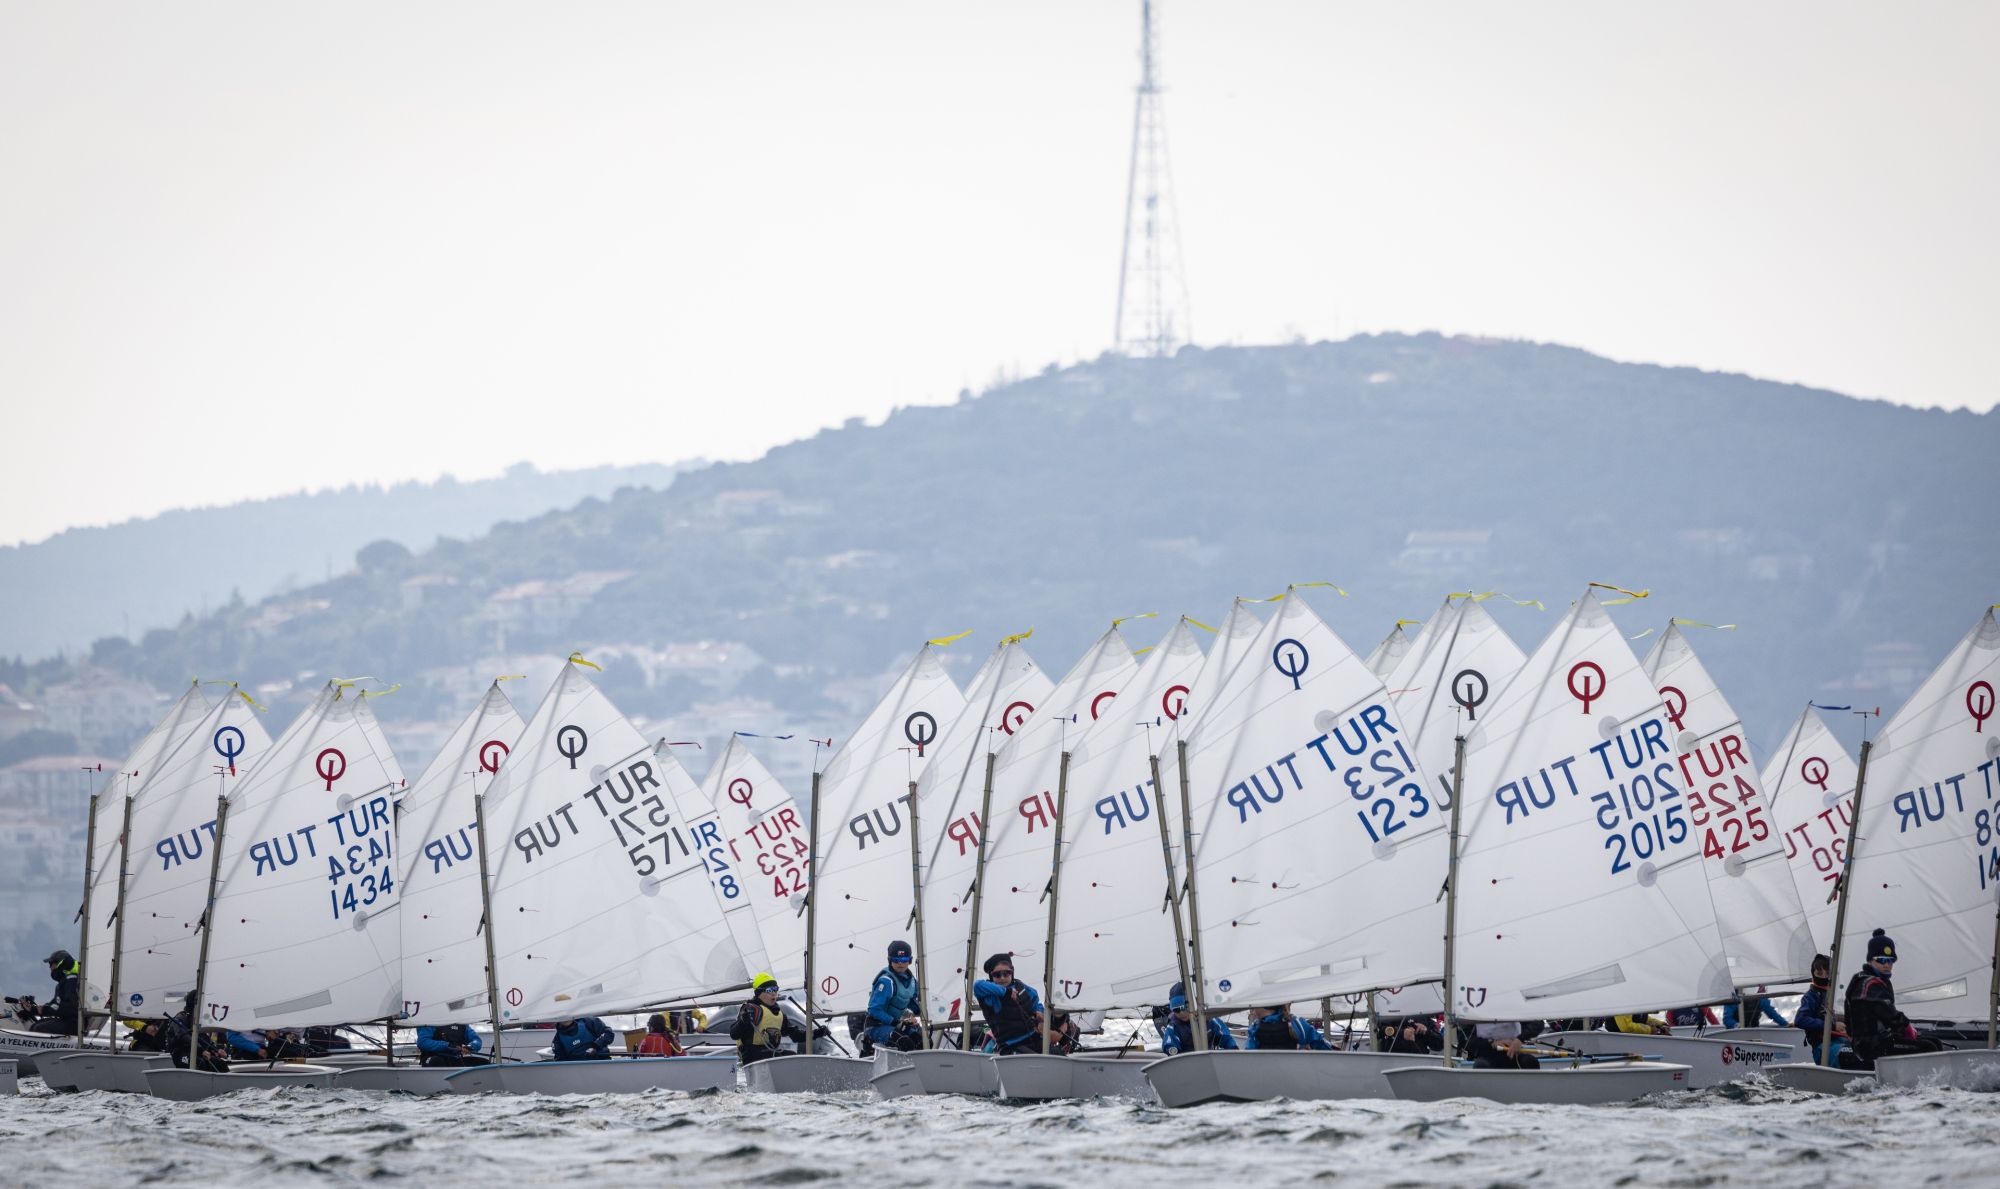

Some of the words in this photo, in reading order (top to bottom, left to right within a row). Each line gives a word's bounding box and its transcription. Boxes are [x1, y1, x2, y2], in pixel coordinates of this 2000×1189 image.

[1306, 704, 1398, 772] TUR
[1590, 719, 1670, 780] TUR
[1678, 734, 1748, 788] TUR
[583, 760, 660, 817] TUR
[1357, 782, 1430, 844] 123
[328, 797, 390, 845] TUR
[745, 808, 801, 849] TUR
[1605, 803, 1688, 875] 2015
[1703, 806, 1769, 860] 425
[628, 826, 690, 876] 571
[331, 866, 394, 919] 1434
[8, 1038, 40, 1047] YELKEN
[1734, 1046, 1774, 1066] Süperpar
